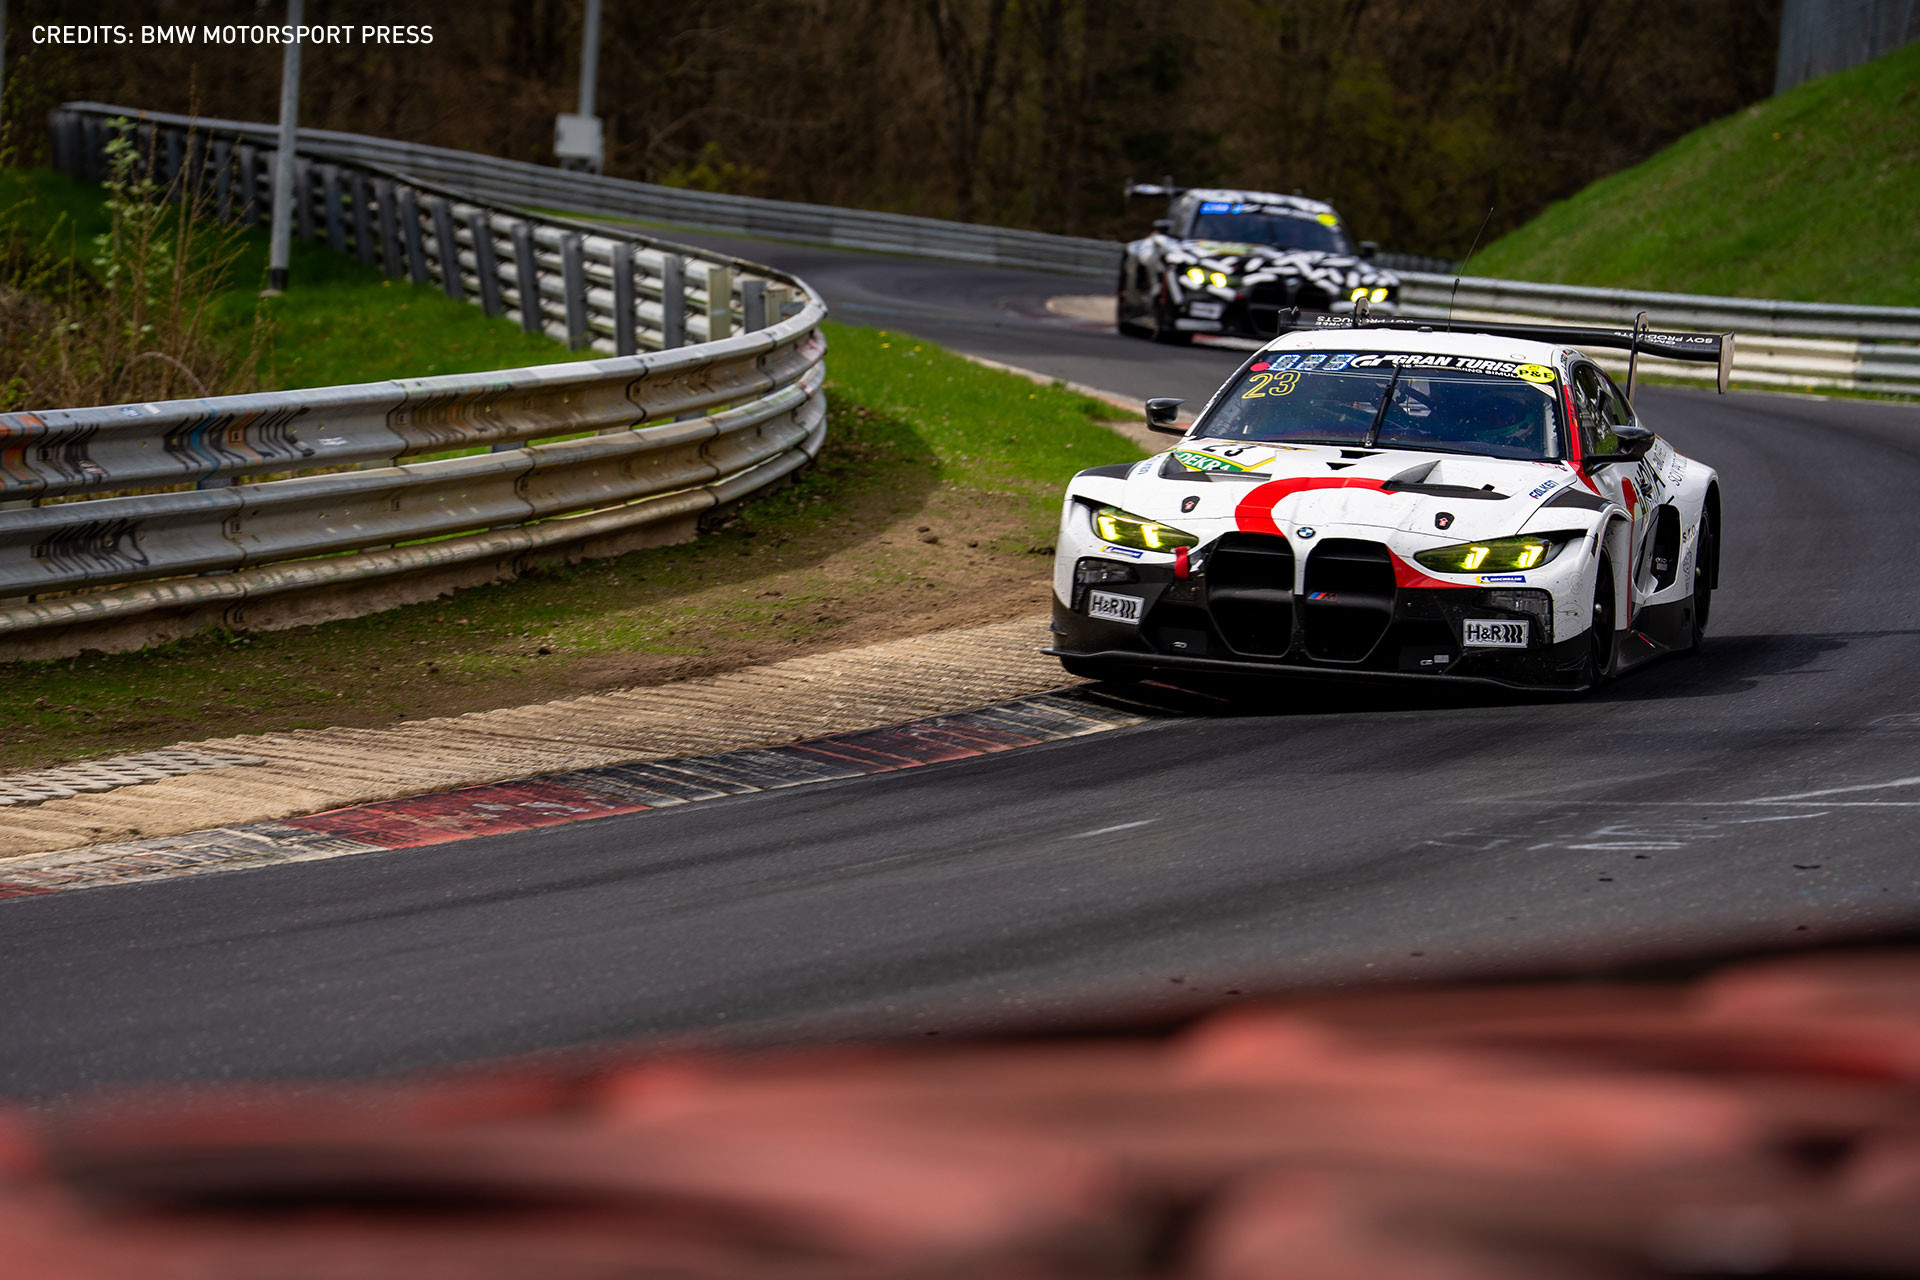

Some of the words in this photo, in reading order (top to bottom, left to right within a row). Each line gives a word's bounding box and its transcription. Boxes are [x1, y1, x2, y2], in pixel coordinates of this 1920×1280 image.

[1686, 336, 1714, 345] SOY
[1392, 355, 1453, 366] GRAN
[1241, 370, 1301, 399] 23
[1180, 452, 1232, 471] DEKRA
[1467, 623, 1502, 641] H&R
